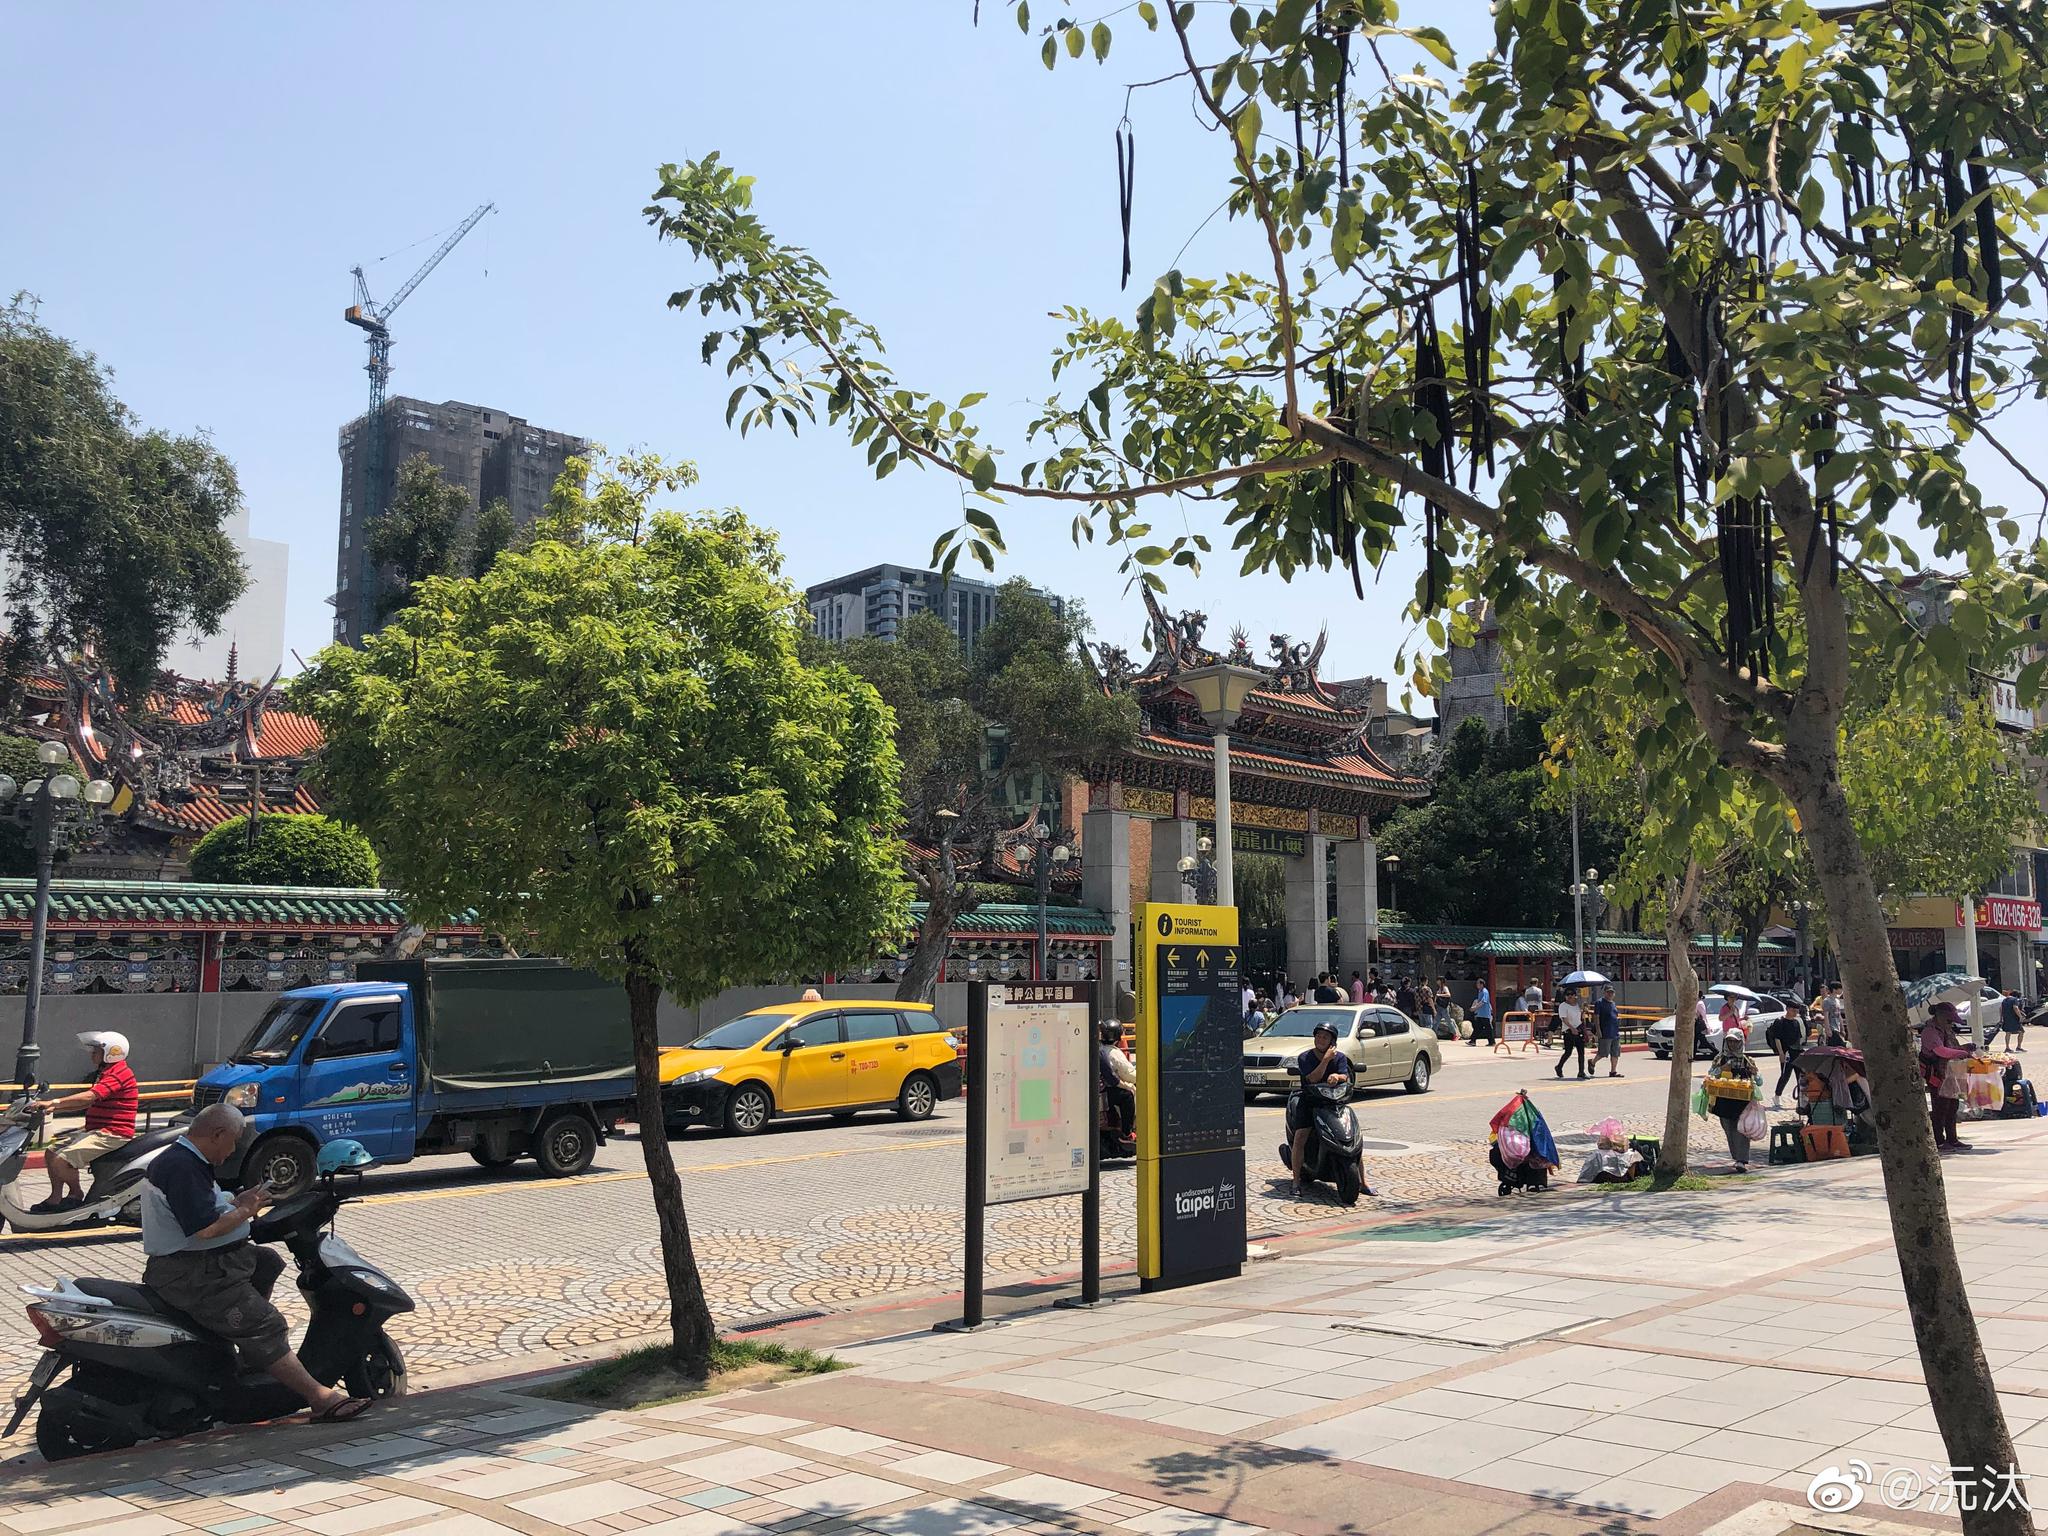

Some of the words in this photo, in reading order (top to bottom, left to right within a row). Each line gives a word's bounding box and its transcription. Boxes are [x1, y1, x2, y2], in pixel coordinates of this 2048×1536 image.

[1993, 902, 2041, 928] 0921-056-328
[1175, 918, 1202, 927] TOURIST
[1174, 927, 1218, 937] INFORMATION
[1181, 1185, 1215, 1198] undiscovered
[1175, 1192, 1215, 1217] taipei
